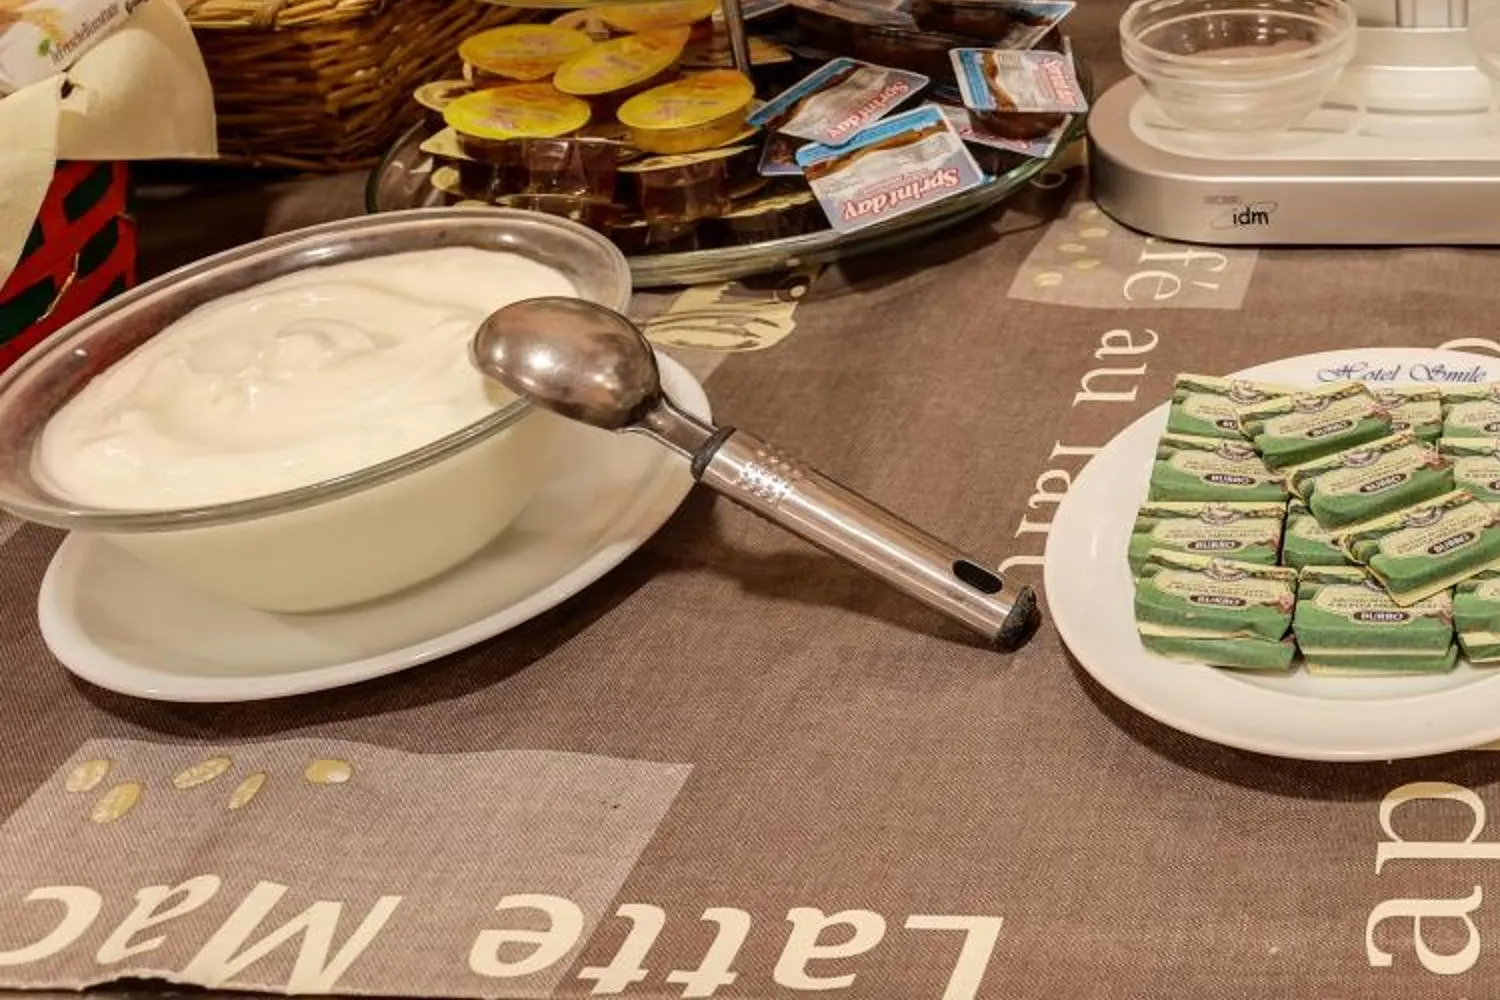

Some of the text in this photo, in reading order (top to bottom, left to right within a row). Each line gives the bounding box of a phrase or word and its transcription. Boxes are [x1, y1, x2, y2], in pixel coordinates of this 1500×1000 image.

[842, 166, 960, 221] Sprintday
[1232, 206, 1269, 225] idm
[1072, 327, 1159, 407] au
[1317, 361, 1487, 383] Hotel Smile
[467, 893, 1006, 1000] Latte
